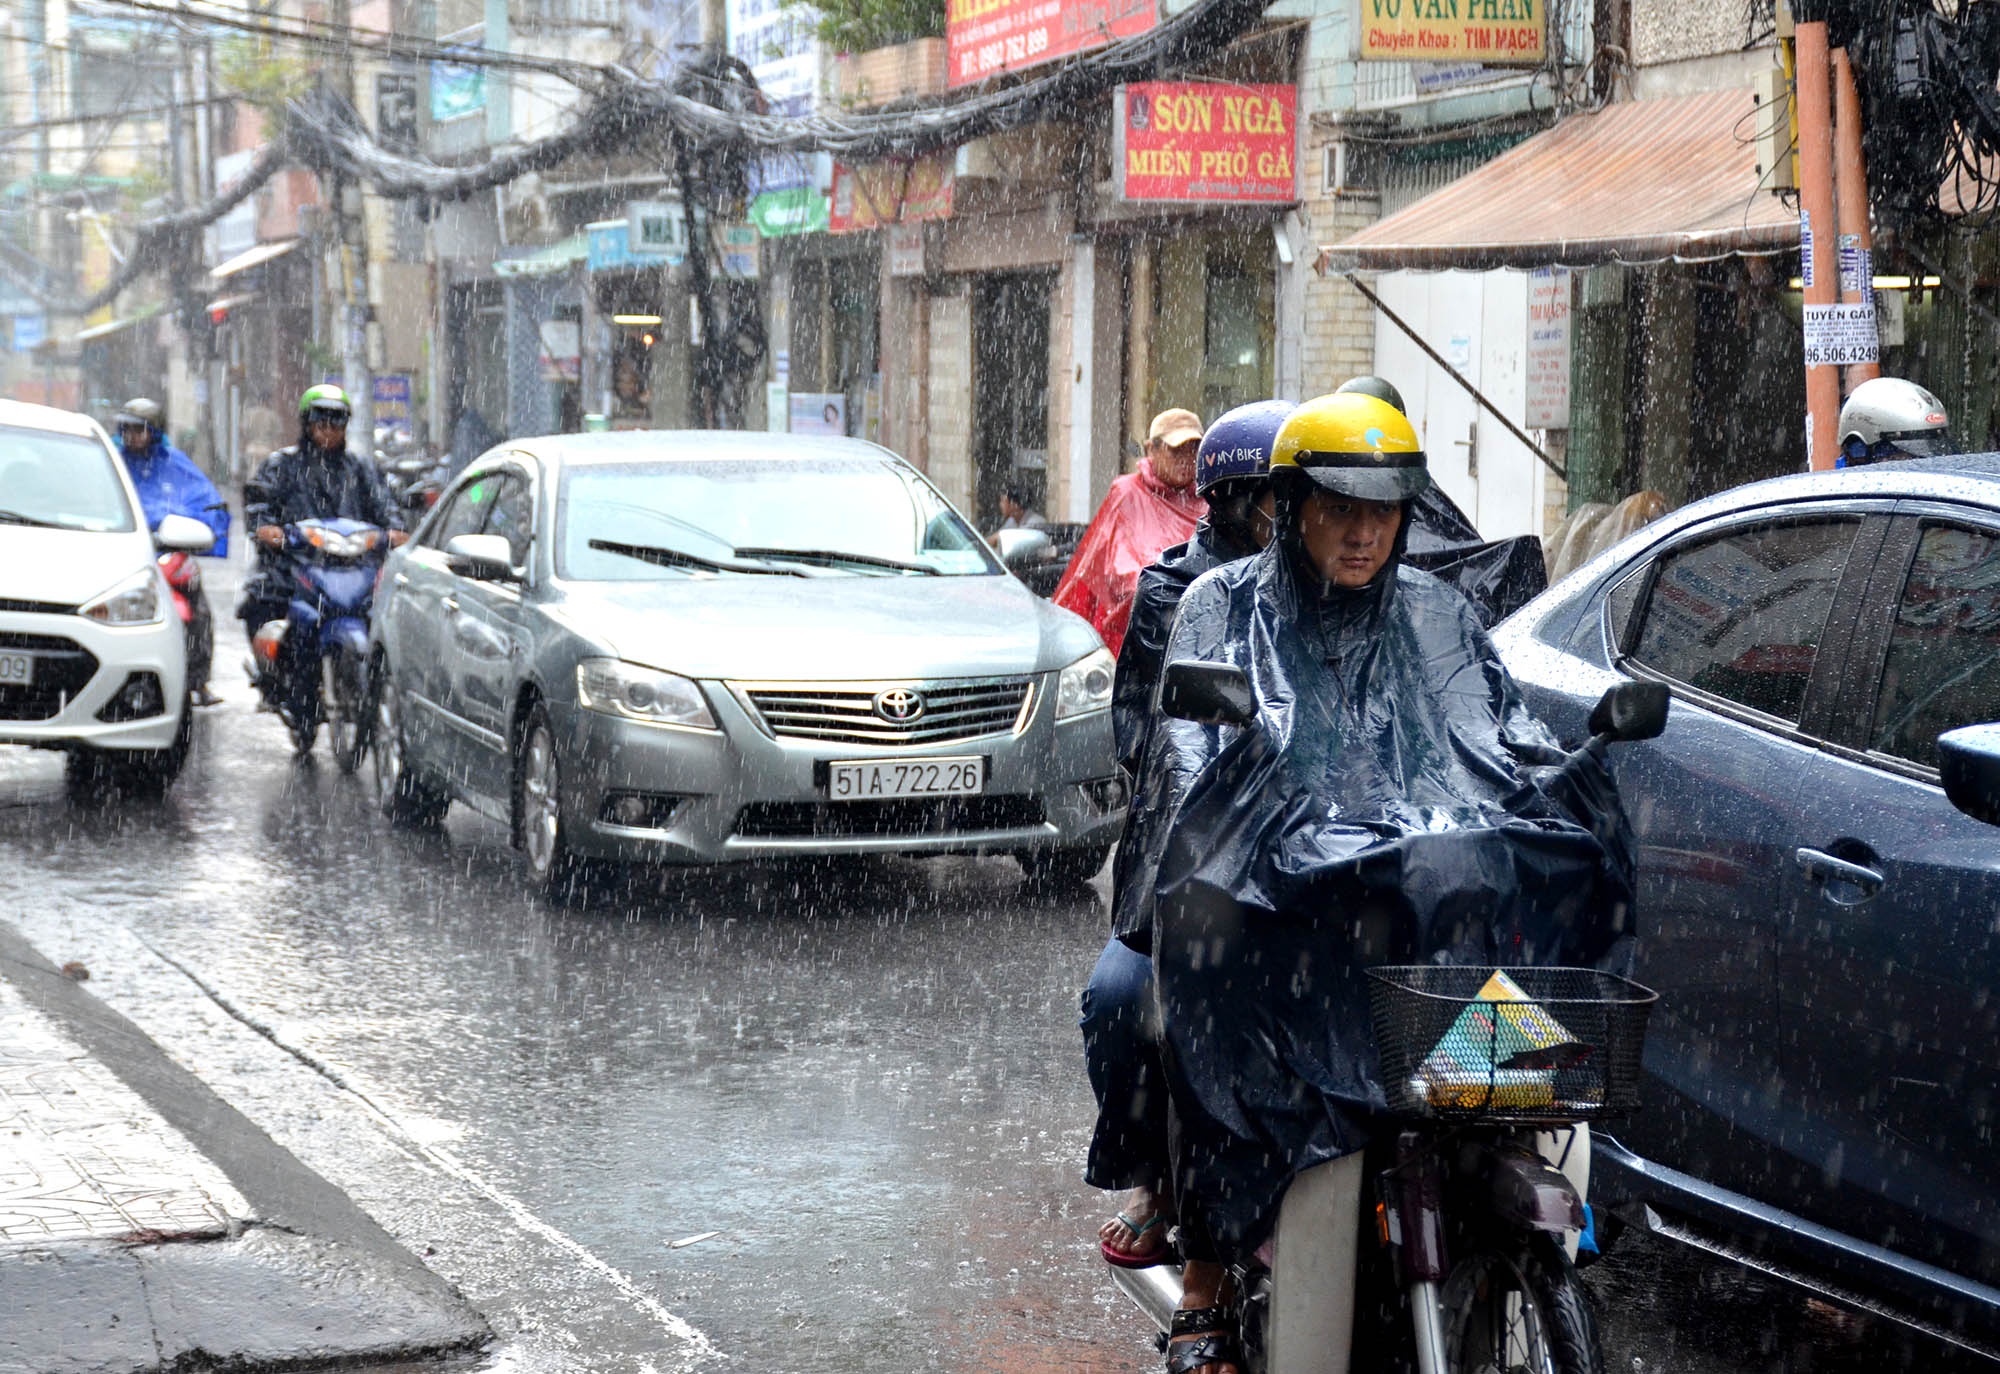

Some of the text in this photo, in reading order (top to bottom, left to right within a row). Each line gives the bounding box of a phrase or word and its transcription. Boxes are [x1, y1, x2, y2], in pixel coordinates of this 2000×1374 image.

[1369, 27, 1414, 51] Chuyên
[1464, 27, 1490, 49] TIM
[1495, 27, 1538, 56] MẠCH
[1154, 89, 1286, 134] SƠN NGA
[1129, 138, 1292, 178] MIẾN PHỞ GÀ
[1217, 449, 1235, 465] MY
[1237, 448, 1263, 461] BIKE
[837, 763, 977, 796] 51A-722.26
